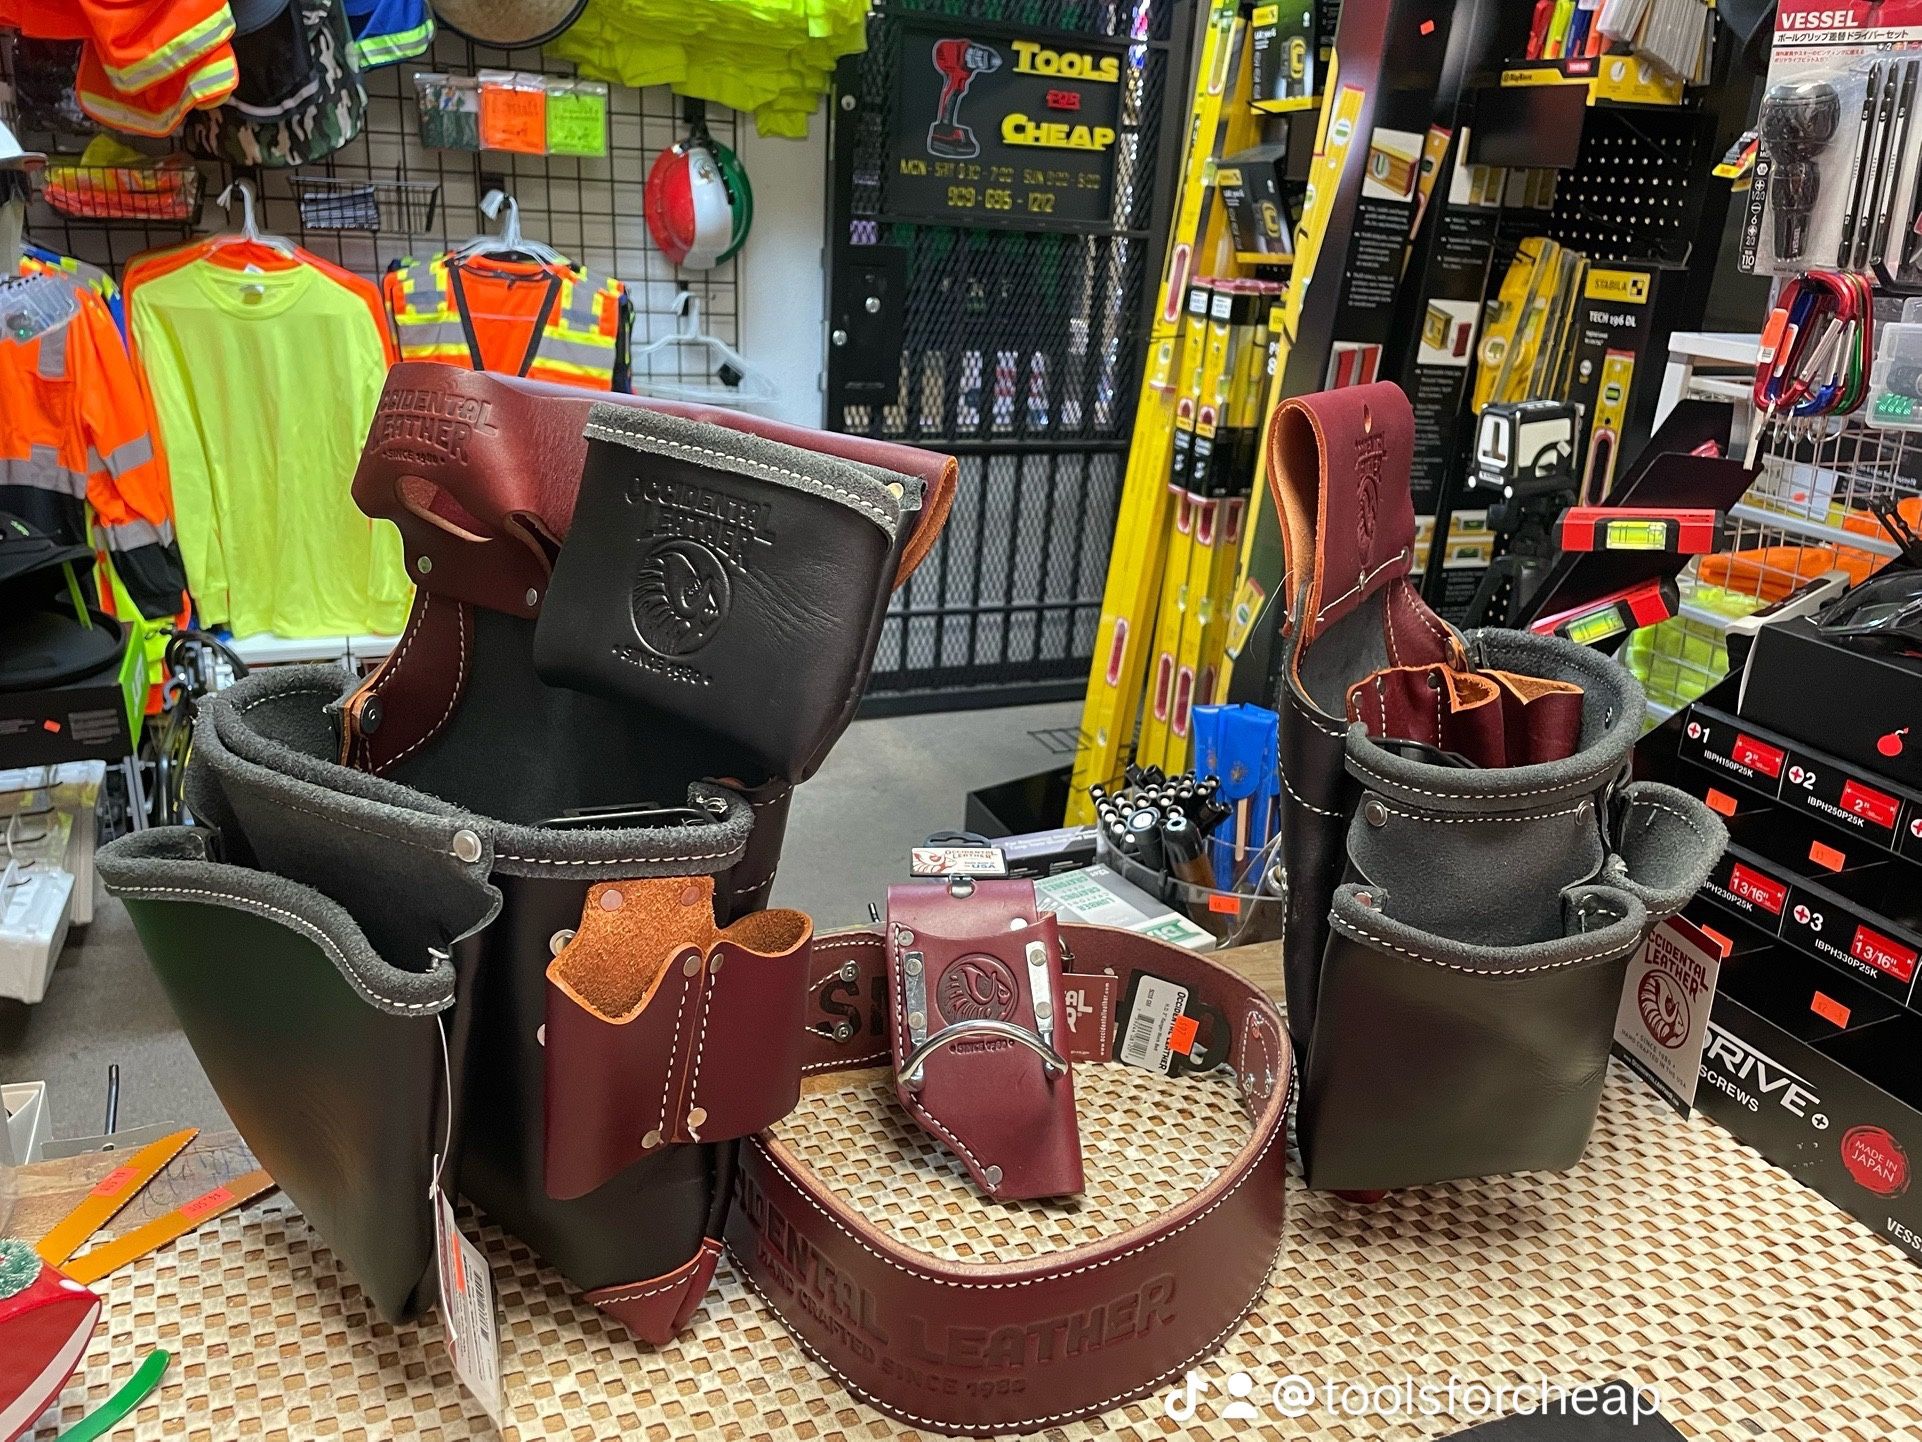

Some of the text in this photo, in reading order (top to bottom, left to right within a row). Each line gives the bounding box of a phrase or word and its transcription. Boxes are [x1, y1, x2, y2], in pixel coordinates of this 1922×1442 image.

[1781, 10, 1859, 29] VESSEL
[1011, 40, 1119, 81] TOOLS
[1046, 89, 1081, 109] FOR
[1002, 113, 1115, 149] CHEAP
[901, 159, 927, 176] MON
[1023, 168, 1044, 184] SUN
[948, 186, 975, 207] 909
[1589, 311, 1609, 323] TECH
[1703, 727, 1710, 744] 1
[1704, 749, 1754, 778] IBPH150P25K
[1803, 771, 1816, 790] 2
[1807, 795, 1865, 827] IBPH250P25K
[1732, 878, 1740, 890] 1
[1078, 897, 1116, 912] LUMBER
[1810, 912, 1824, 931] 3
[1648, 930, 1708, 991] CCIDENTAL
[1815, 938, 1878, 979] IBPH330P25K
[1855, 941, 1862, 954] 1
[1863, 945, 1897, 969] 3/16"
[1645, 942, 1698, 1003] LEATHER
[1700, 1064, 1759, 1112] SCREWS
[1851, 1149, 1895, 1183] JAPAN
[1855, 1140, 1898, 1172] MADE IN
[1886, 1216, 1922, 1254] VESS
[908, 1273, 1178, 1368] LEATHER
[798, 1288, 878, 1364] CRAFTED
[879, 1357, 958, 1395] SINCE
